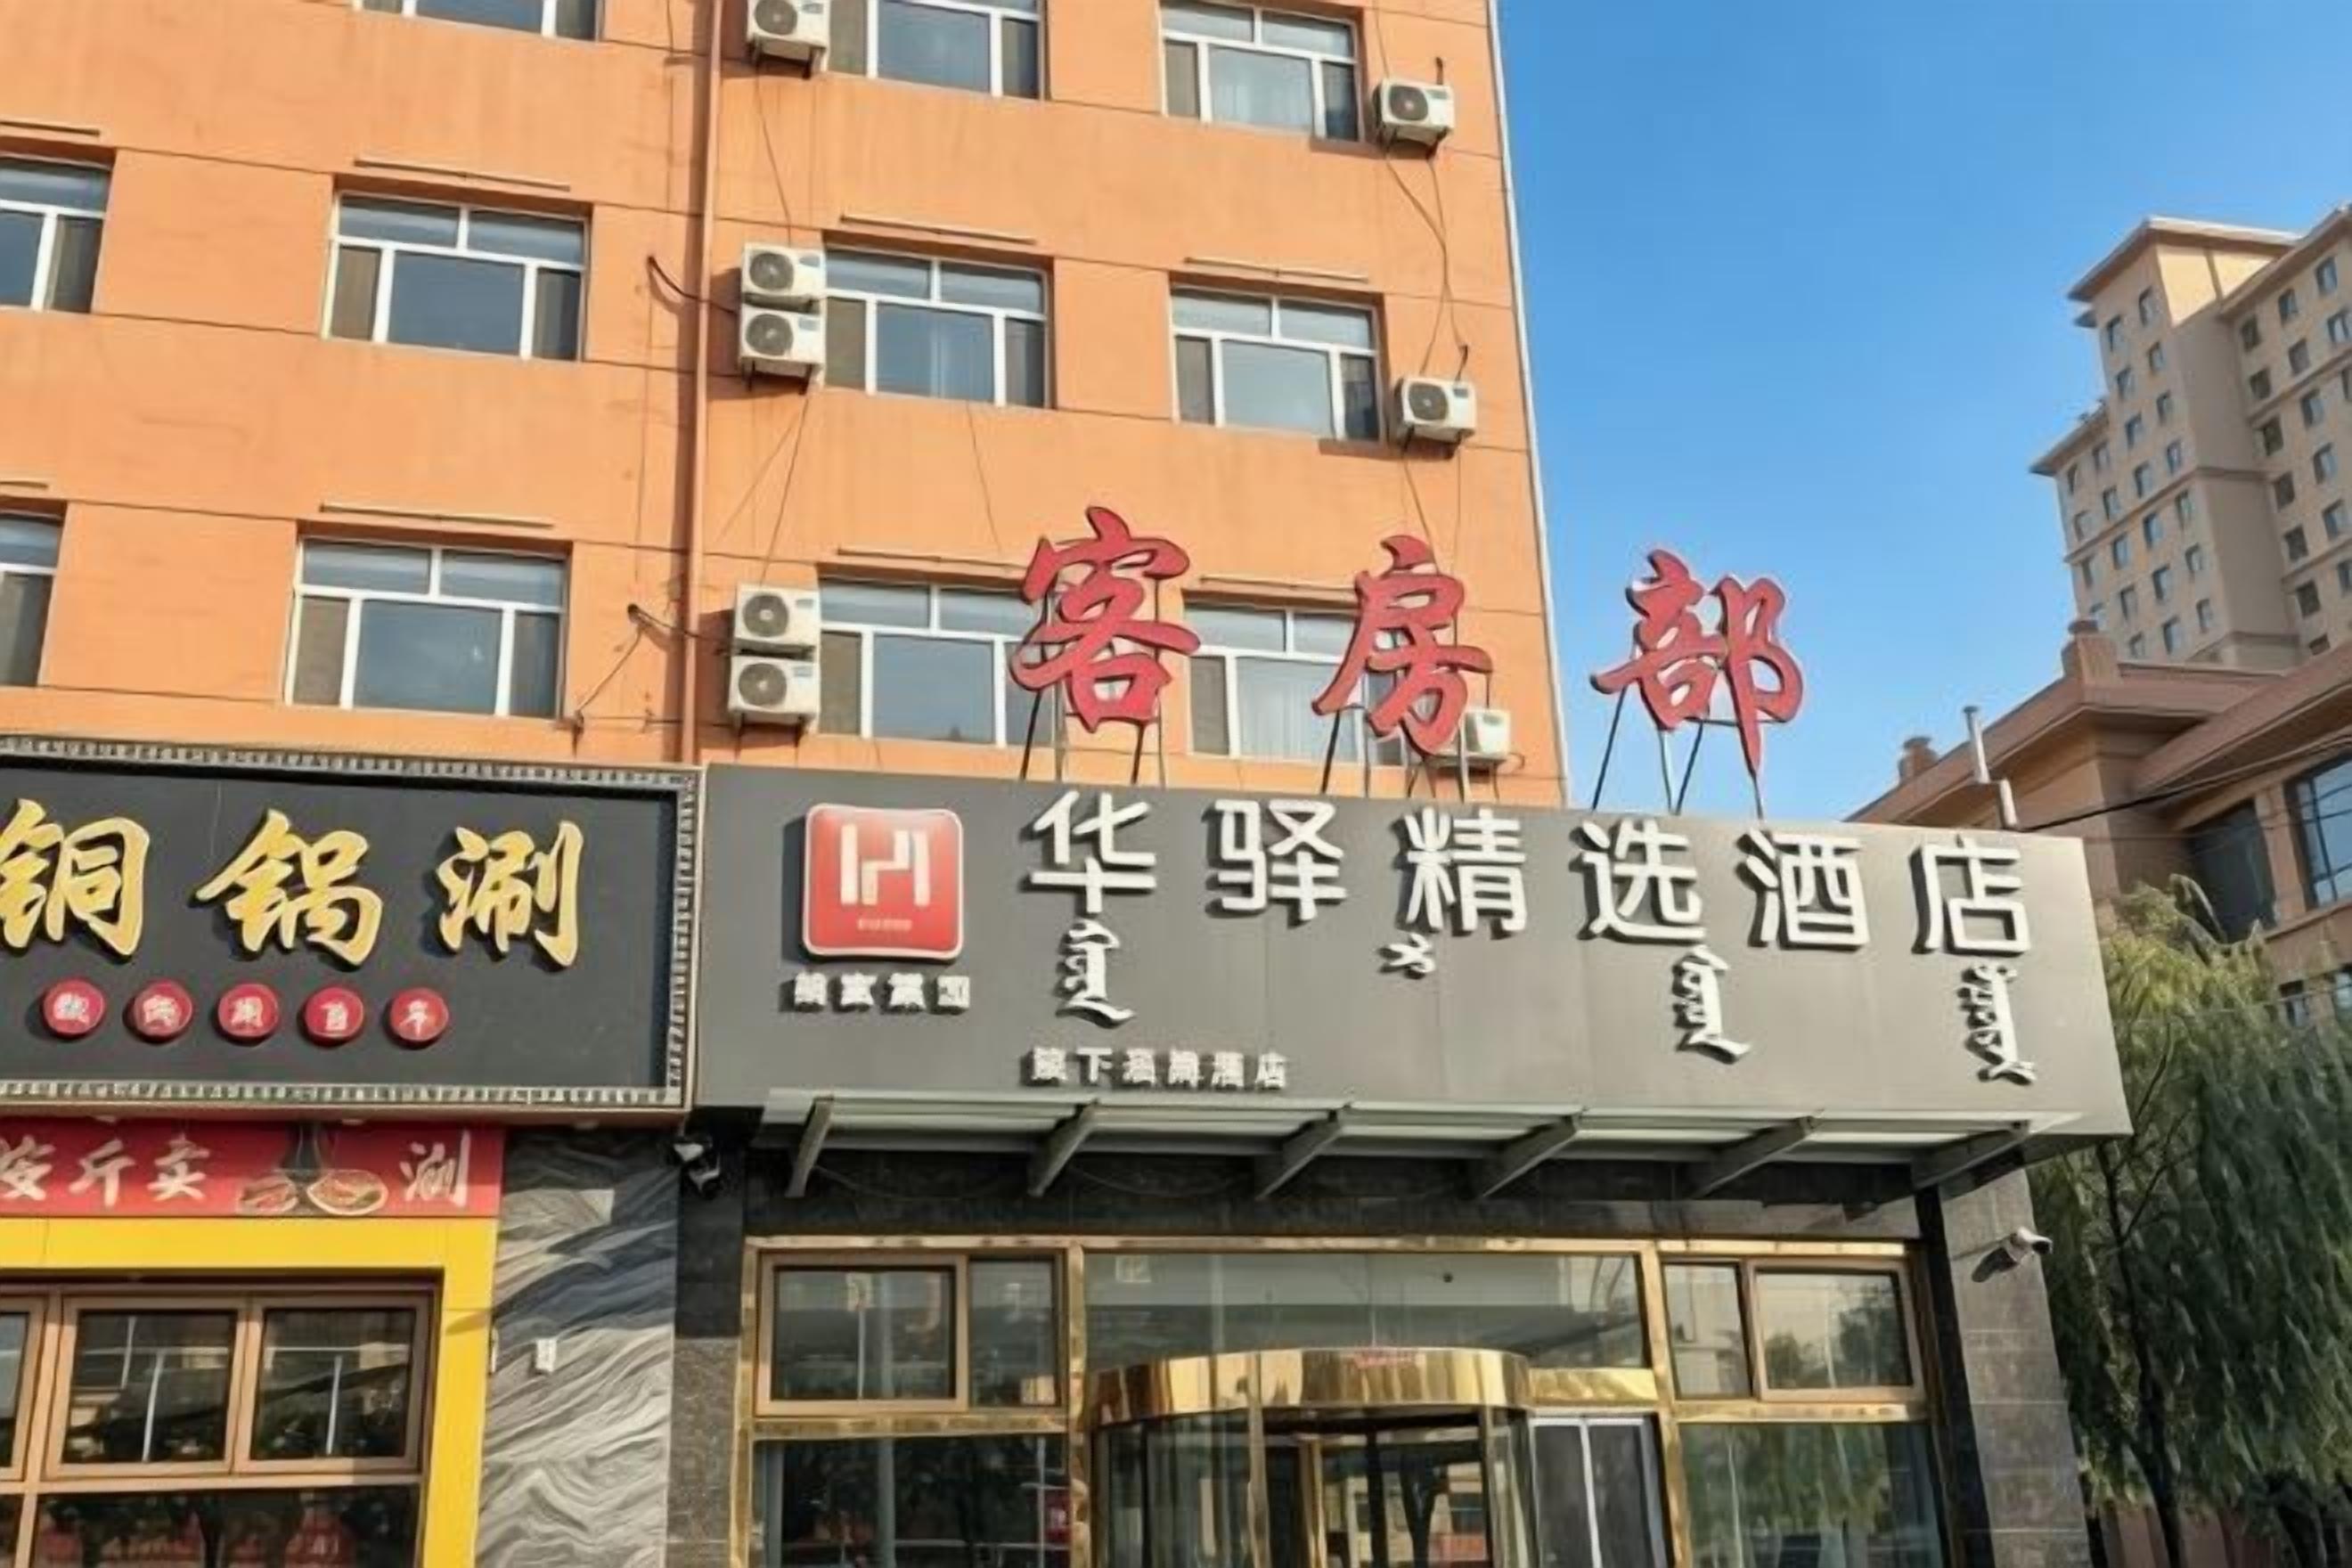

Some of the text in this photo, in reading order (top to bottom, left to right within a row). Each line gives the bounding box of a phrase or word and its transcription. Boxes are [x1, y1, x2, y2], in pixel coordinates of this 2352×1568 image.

[1010, 506, 1804, 777] 客房部
[0, 799, 584, 967] 铜锅涮
[1027, 790, 2031, 953] 华驿精选酒店
